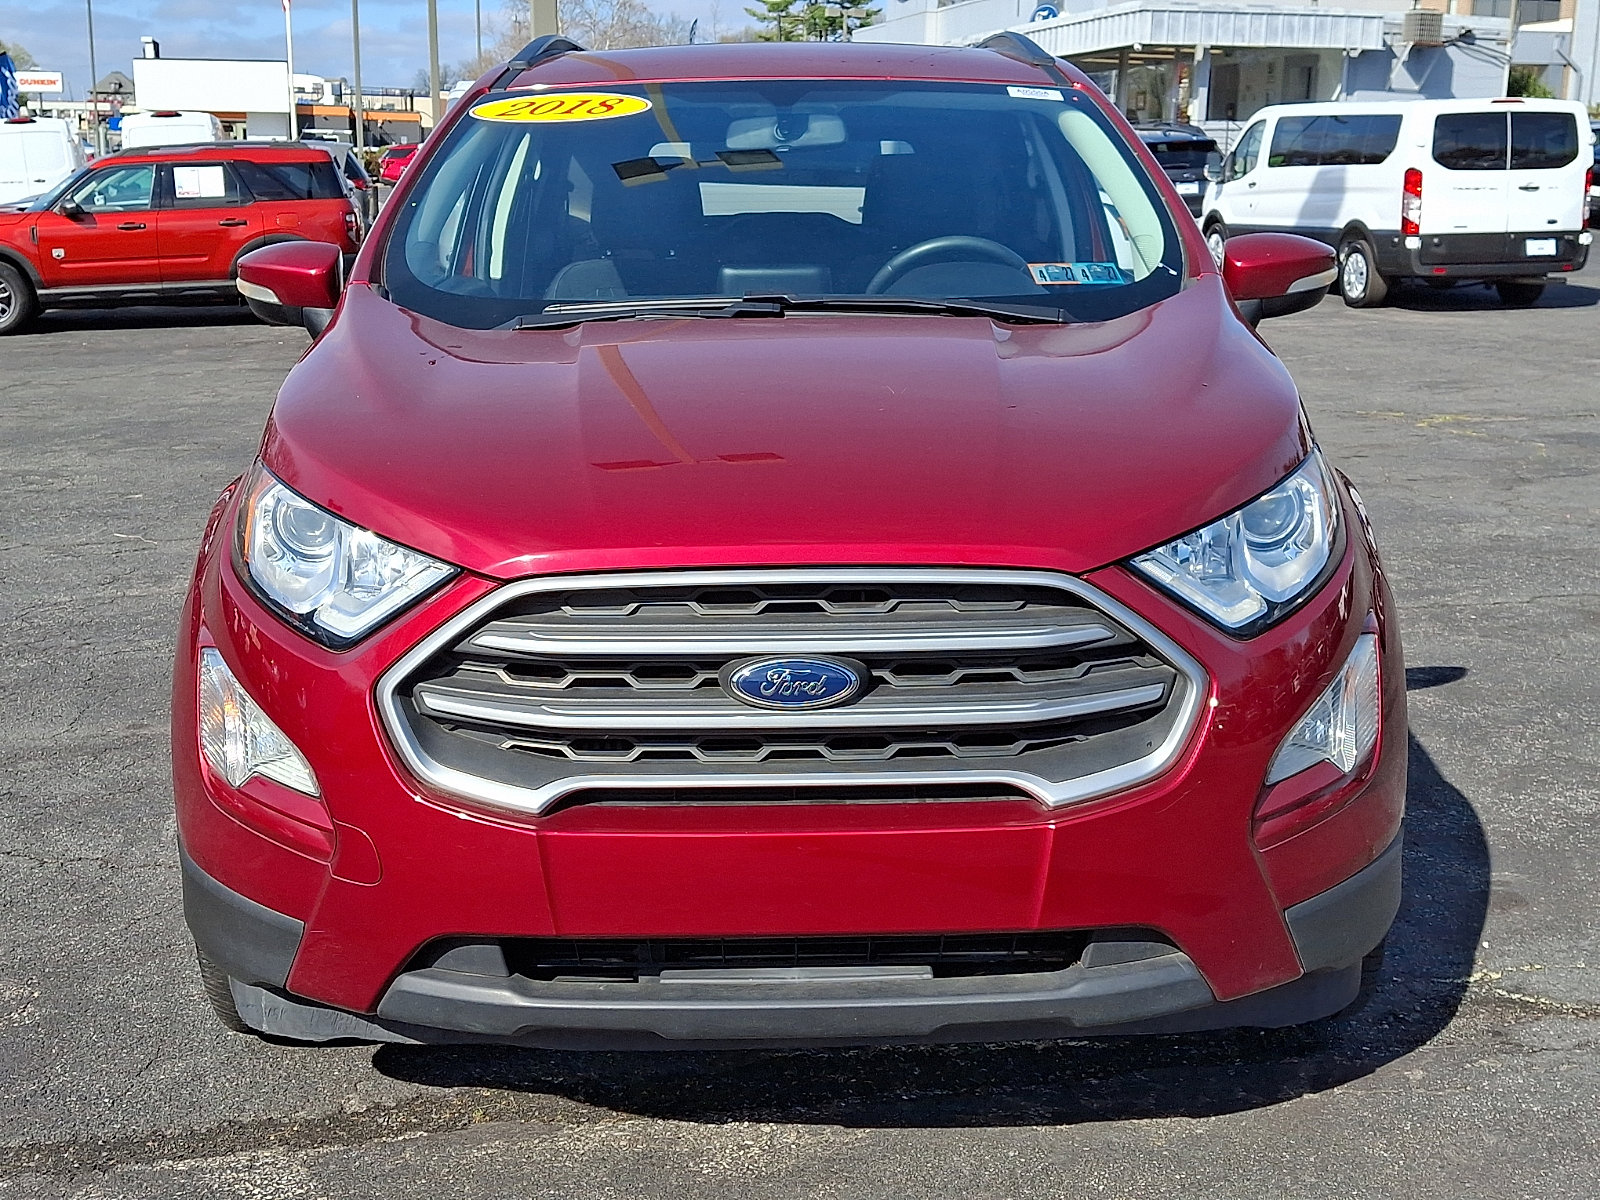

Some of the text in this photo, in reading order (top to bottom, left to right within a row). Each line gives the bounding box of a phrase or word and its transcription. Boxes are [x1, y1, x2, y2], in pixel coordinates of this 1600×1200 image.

[495, 98, 625, 117] 2018
[1038, 266, 1075, 282] 4 27
[1081, 268, 1090, 281] 4
[759, 667, 828, 697] Ford
